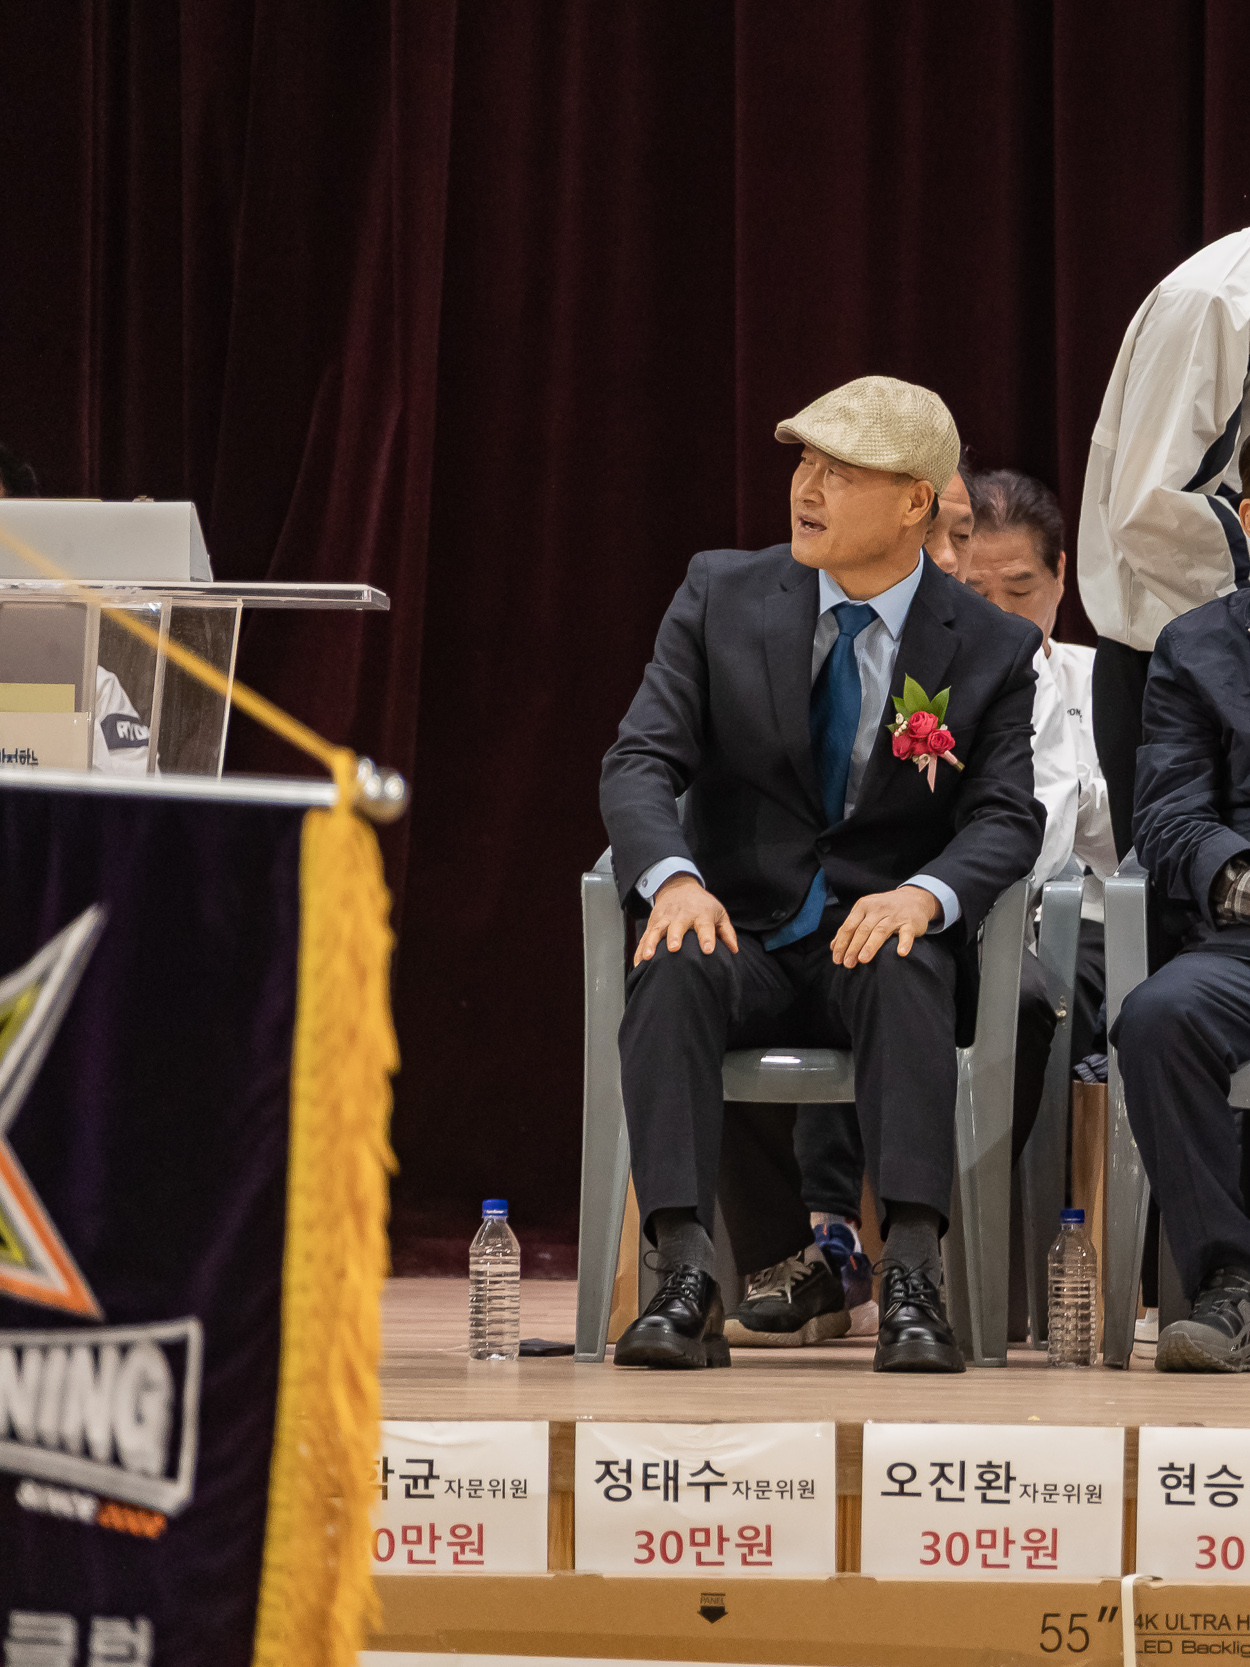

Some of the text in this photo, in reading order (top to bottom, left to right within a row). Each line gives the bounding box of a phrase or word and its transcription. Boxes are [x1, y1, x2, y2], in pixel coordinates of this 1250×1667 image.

[444, 1478, 528, 1499] 자문위원
[594, 1458, 816, 1503] 정태수 자문위원
[880, 1460, 1102, 1505] 오진환 자문위원
[635, 1524, 773, 1567] 30만원
[919, 1526, 1058, 1570] 30만원
[1133, 1613, 1159, 1631] 4K
[1165, 1613, 1232, 1631] ULTRA
